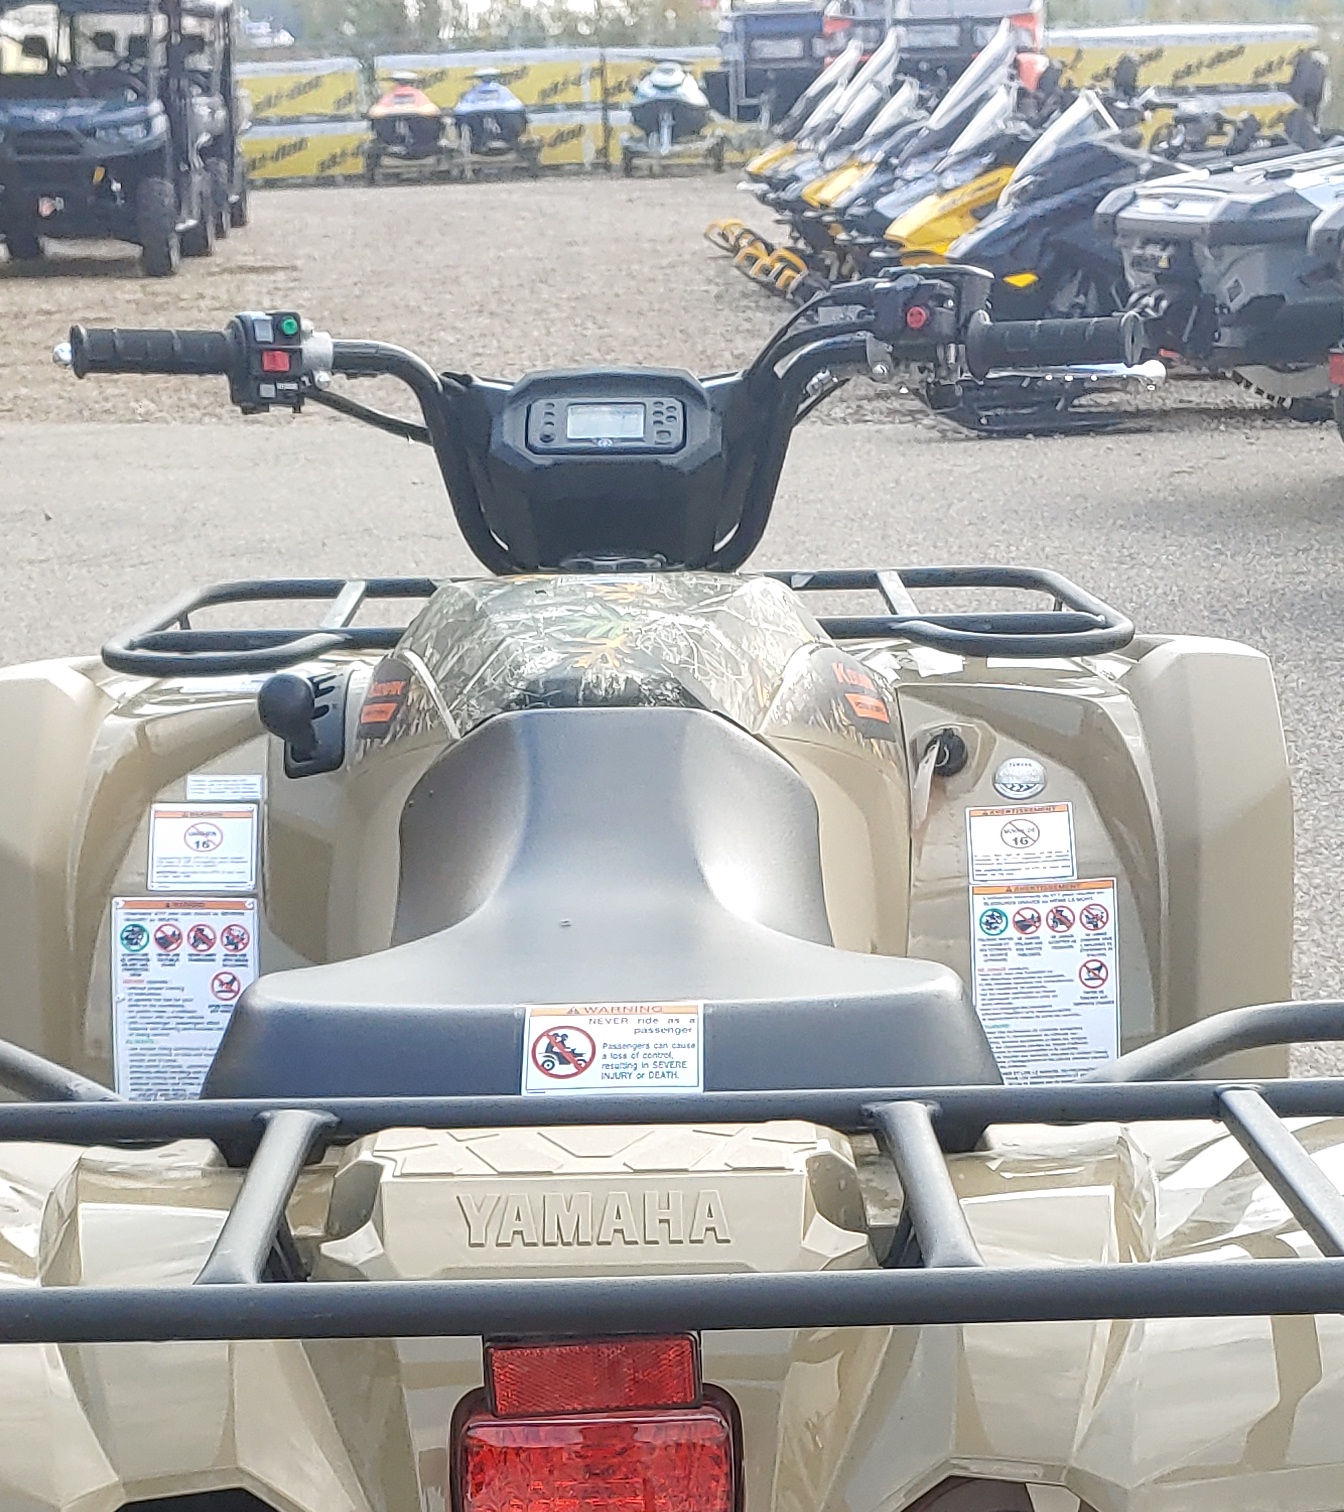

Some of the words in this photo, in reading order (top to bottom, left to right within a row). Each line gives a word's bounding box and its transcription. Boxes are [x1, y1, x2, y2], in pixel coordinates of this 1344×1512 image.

[584, 1005, 663, 1014] WARNING
[589, 1017, 629, 1025] NEVER
[637, 1017, 659, 1025] ride
[634, 1027, 692, 1035] passenger
[602, 1042, 651, 1051] Passengers
[642, 1052, 674, 1060] control,
[601, 1061, 638, 1070] resulting
[652, 1061, 688, 1069] SEVERE
[601, 1072, 633, 1080] INJURY
[648, 1071, 680, 1079] DEATH.
[456, 1189, 731, 1247] YAMAHA
